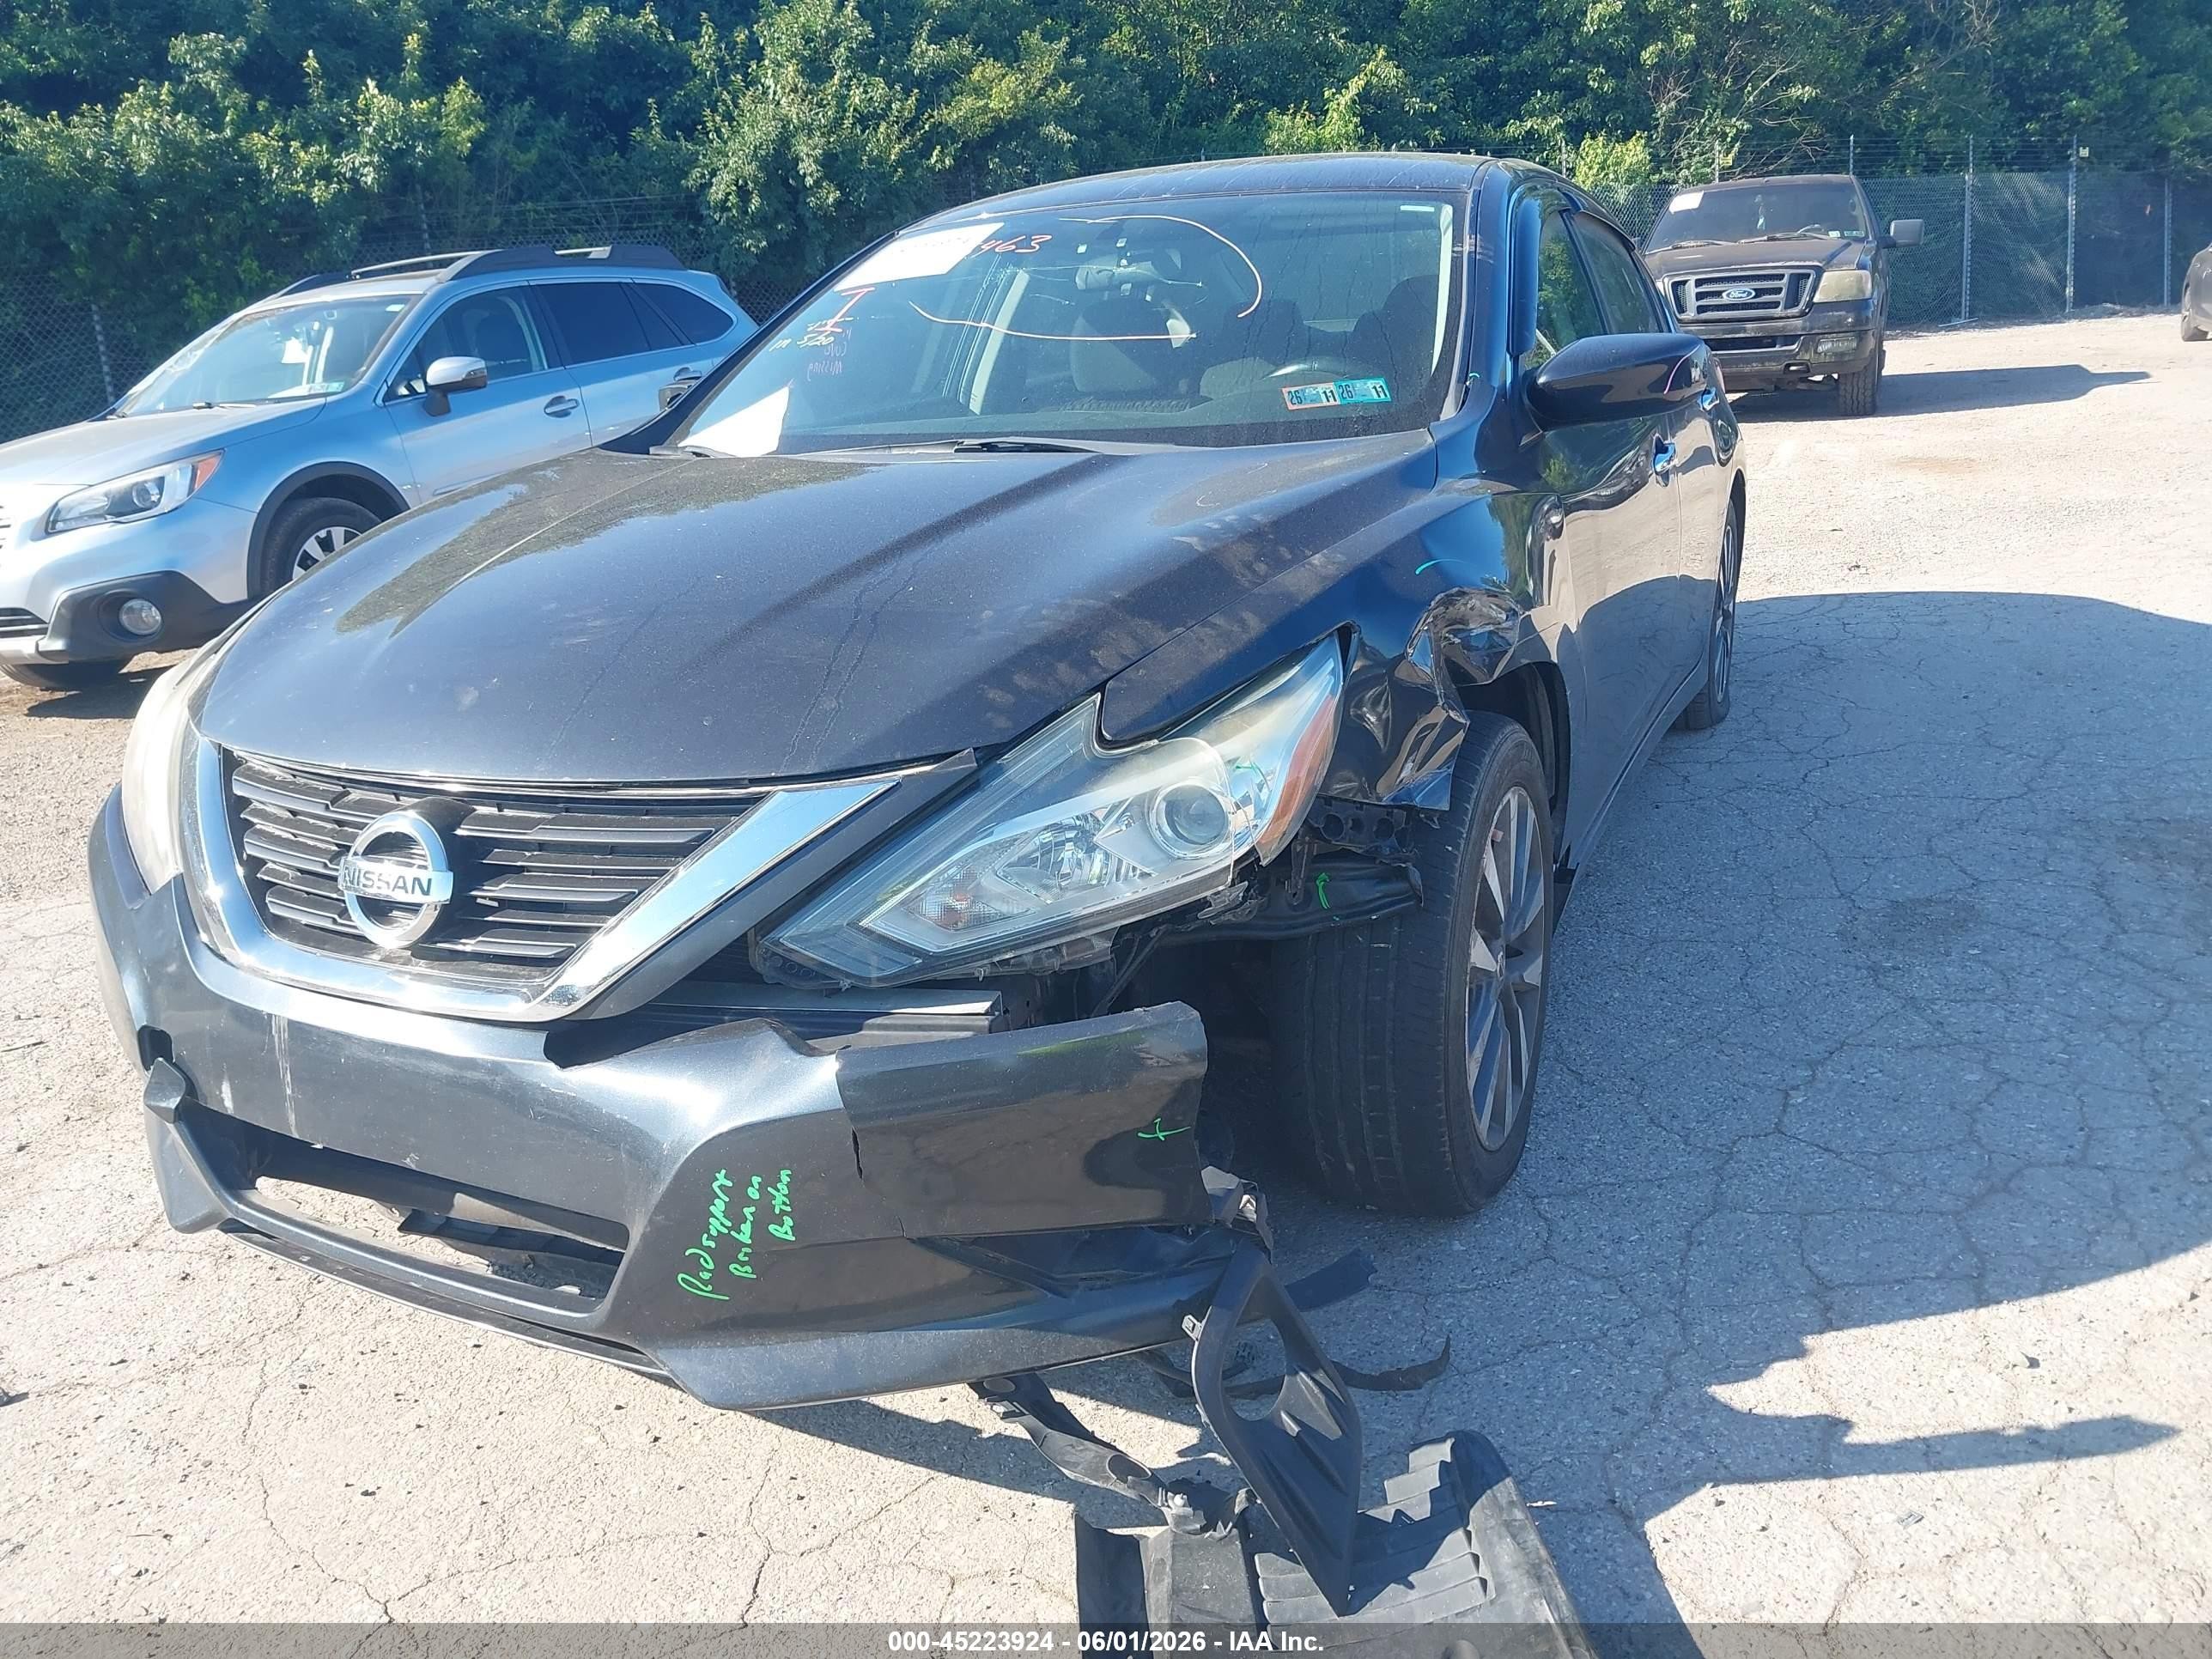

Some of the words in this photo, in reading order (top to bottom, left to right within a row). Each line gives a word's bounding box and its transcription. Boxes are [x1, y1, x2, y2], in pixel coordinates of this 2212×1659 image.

[1287, 390, 1303, 405] 26
[1322, 389, 1337, 403] 11
[1339, 384, 1354, 399] 26
[1372, 385, 1388, 398] 11
[343, 866, 433, 896] NISSAN
[748, 1175, 762, 1199] on
[678, 1248, 729, 1300] Rad
